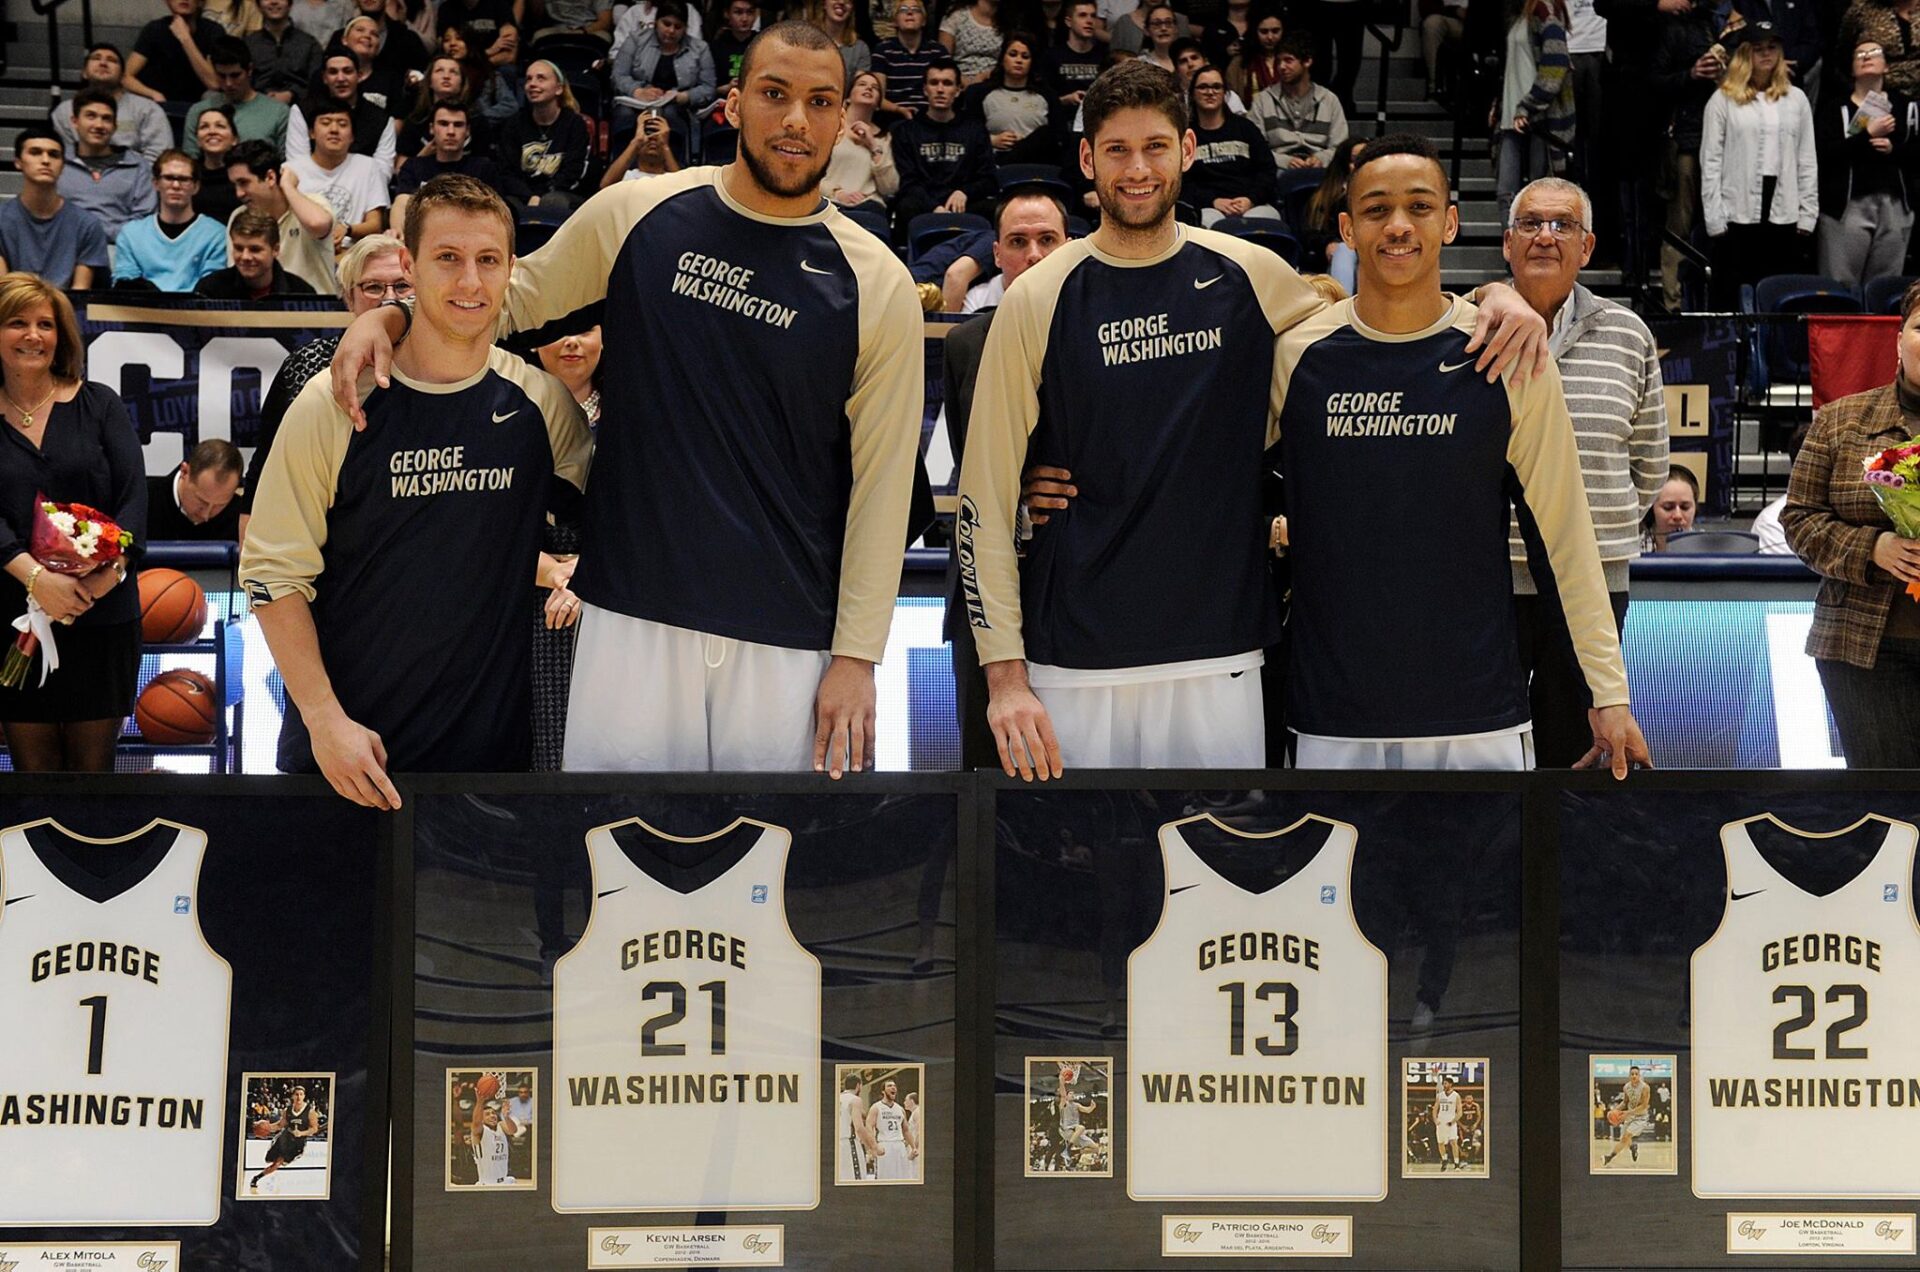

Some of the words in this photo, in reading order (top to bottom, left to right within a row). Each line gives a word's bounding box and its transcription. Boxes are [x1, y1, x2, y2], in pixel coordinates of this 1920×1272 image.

[677, 251, 755, 291] GEORGE
[671, 272, 799, 330] WASHINGTON
[1097, 313, 1169, 345] GEORGE
[1102, 327, 1222, 367] WASHINGTON
[1326, 391, 1404, 414] GEORGE
[1326, 413, 1458, 437] WASHINGTON
[389, 446, 465, 474] GEORGE
[391, 467, 515, 498] WASHINGTON
[31, 941, 160, 985] GEORGE
[621, 929, 746, 971] GEORGE
[1199, 932, 1319, 972] GEORGE
[1762, 933, 1881, 973] GEORGE
[79, 995, 108, 1075] 1
[641, 980, 726, 1057] 21
[1218, 982, 1299, 1056] 13
[1772, 984, 1868, 1060] 22
[568, 1074, 799, 1107] WASHINGTON
[1141, 1074, 1365, 1106] WASHINGTON
[0, 1094, 204, 1129] ASHINGTON
[646, 1234, 680, 1243] KEVIN
[682, 1234, 726, 1242] LARSEN
[1212, 1223, 1260, 1232] PATRICIO
[1262, 1223, 1304, 1232] GARINO
[1780, 1220, 1800, 1229] JOE
[40, 1251, 70, 1260] ALEX
[73, 1251, 116, 1260] MITOLA
